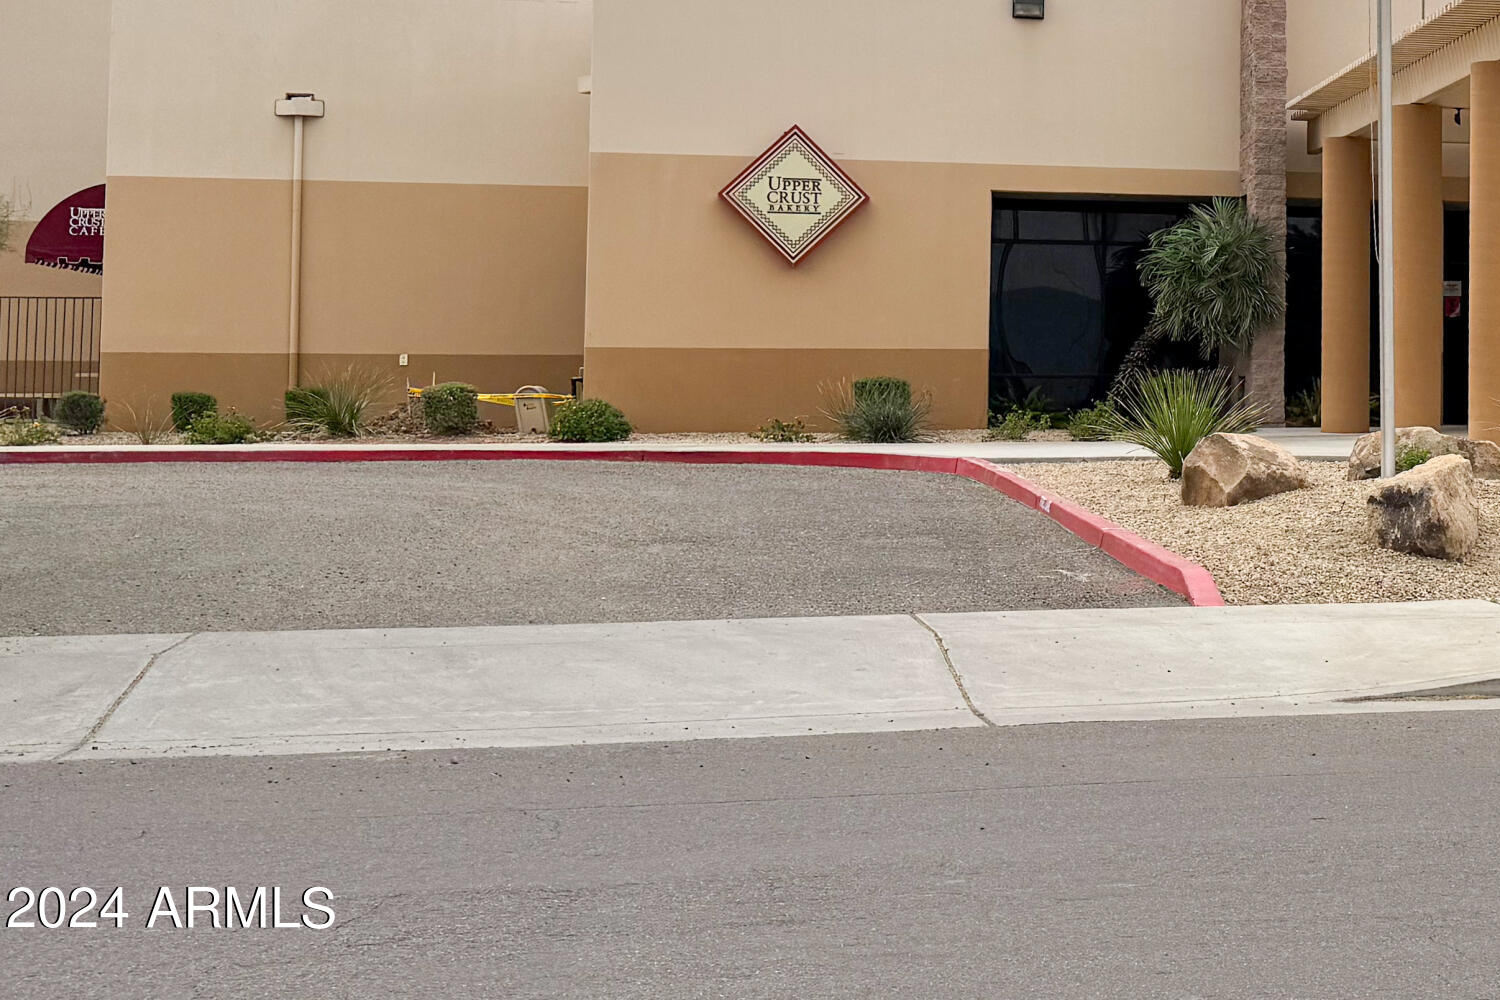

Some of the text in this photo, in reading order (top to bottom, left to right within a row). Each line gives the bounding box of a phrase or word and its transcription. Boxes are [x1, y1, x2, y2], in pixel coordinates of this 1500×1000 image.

[767, 176, 822, 191] UPPER
[767, 191, 822, 204] CRUST
[769, 204, 821, 212] BAKERY
